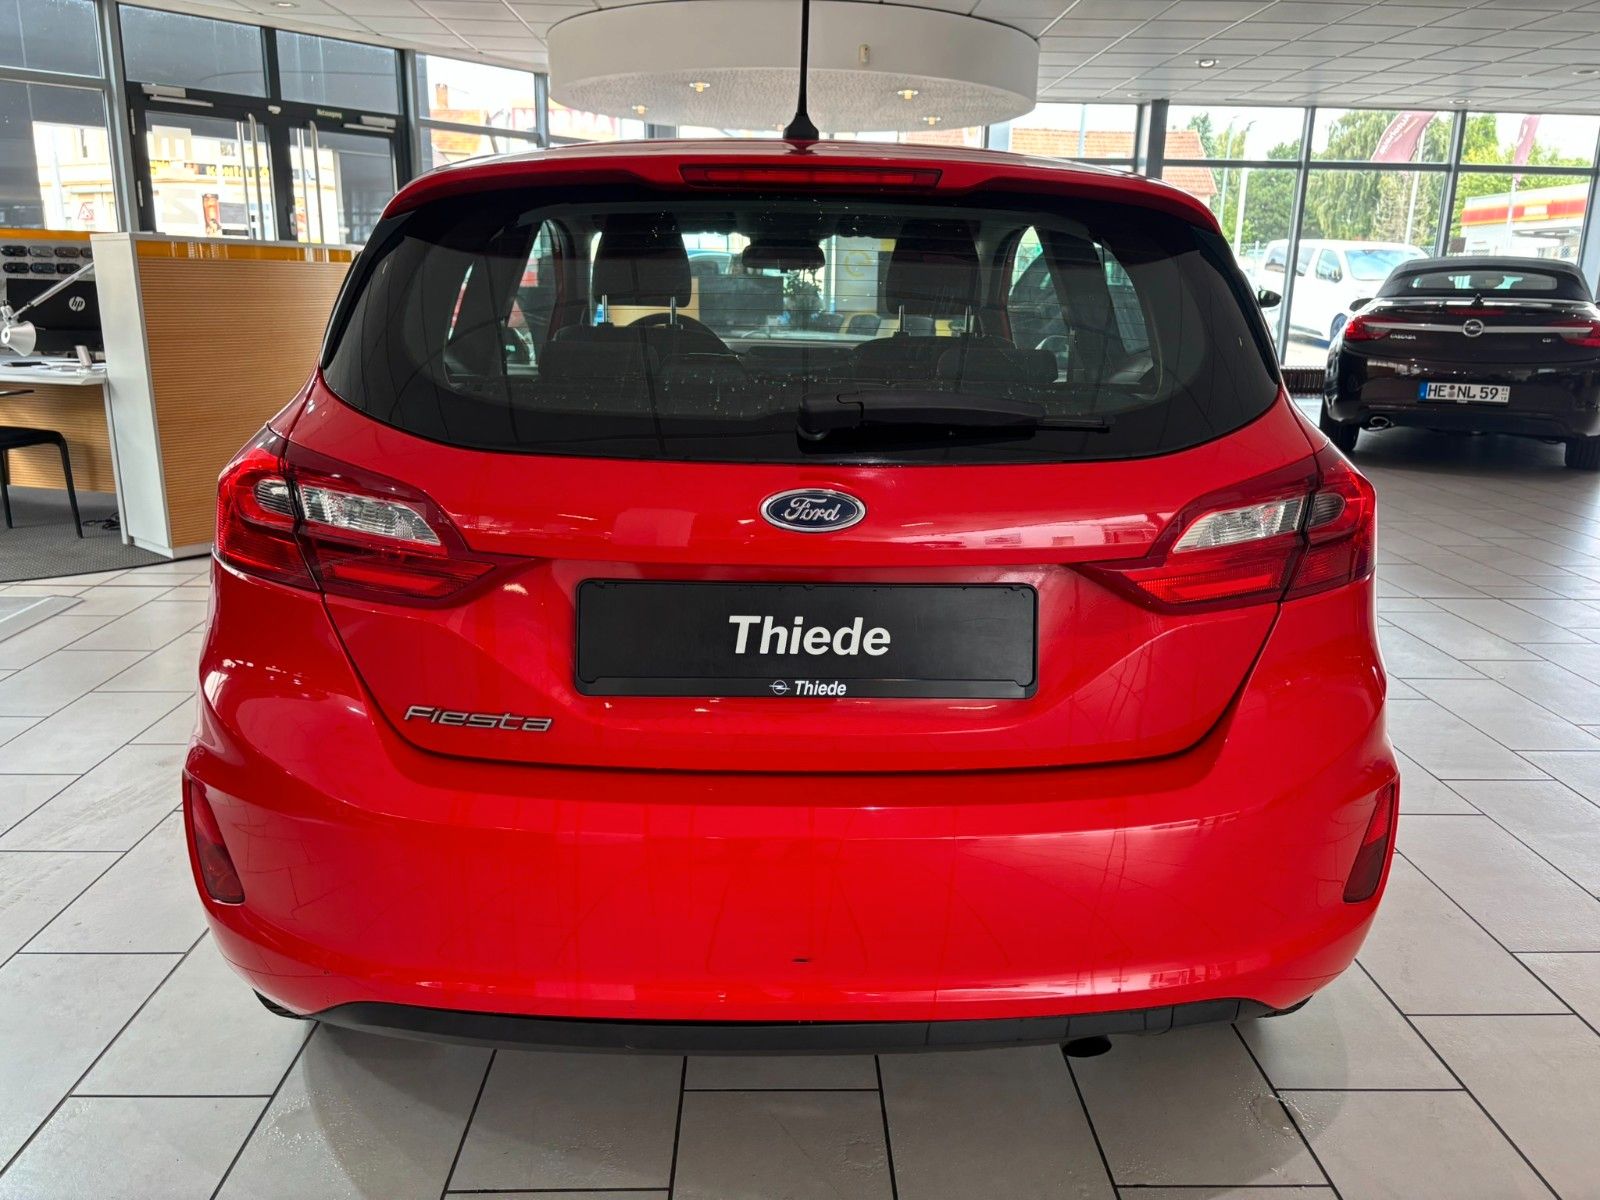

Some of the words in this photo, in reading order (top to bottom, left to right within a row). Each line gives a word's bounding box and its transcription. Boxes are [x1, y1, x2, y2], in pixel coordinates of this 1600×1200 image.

[70, 296, 85, 311] hp
[1427, 384, 1447, 398] HE
[1457, 386, 1476, 399] NL
[1479, 386, 1499, 400] 59
[781, 497, 841, 521] Ford
[728, 615, 891, 656] Thiede
[795, 680, 847, 696] Thiede
[404, 704, 552, 732] Fiesta
